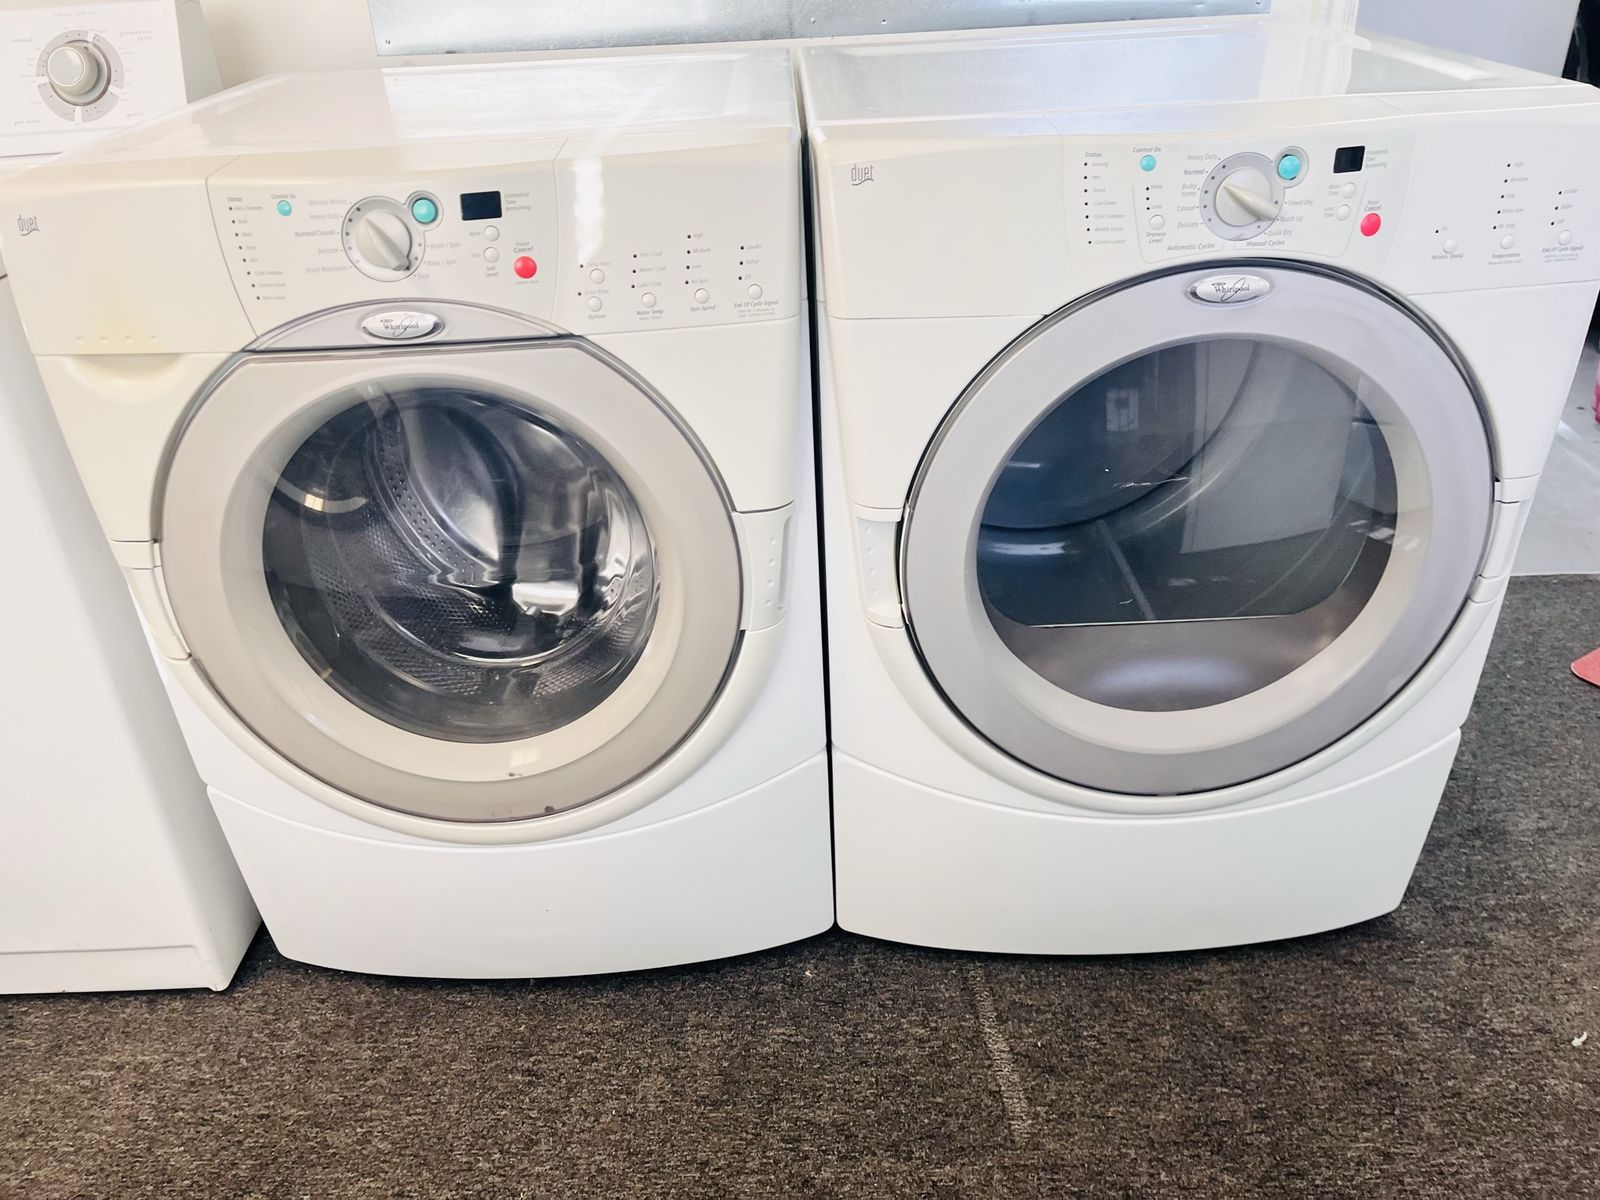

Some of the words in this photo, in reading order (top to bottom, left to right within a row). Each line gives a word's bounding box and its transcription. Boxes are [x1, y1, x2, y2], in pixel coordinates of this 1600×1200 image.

[851, 163, 874, 186] duet
[17, 213, 40, 236] duet
[514, 246, 533, 254] Cancel
[1167, 243, 1196, 251] Automatic
